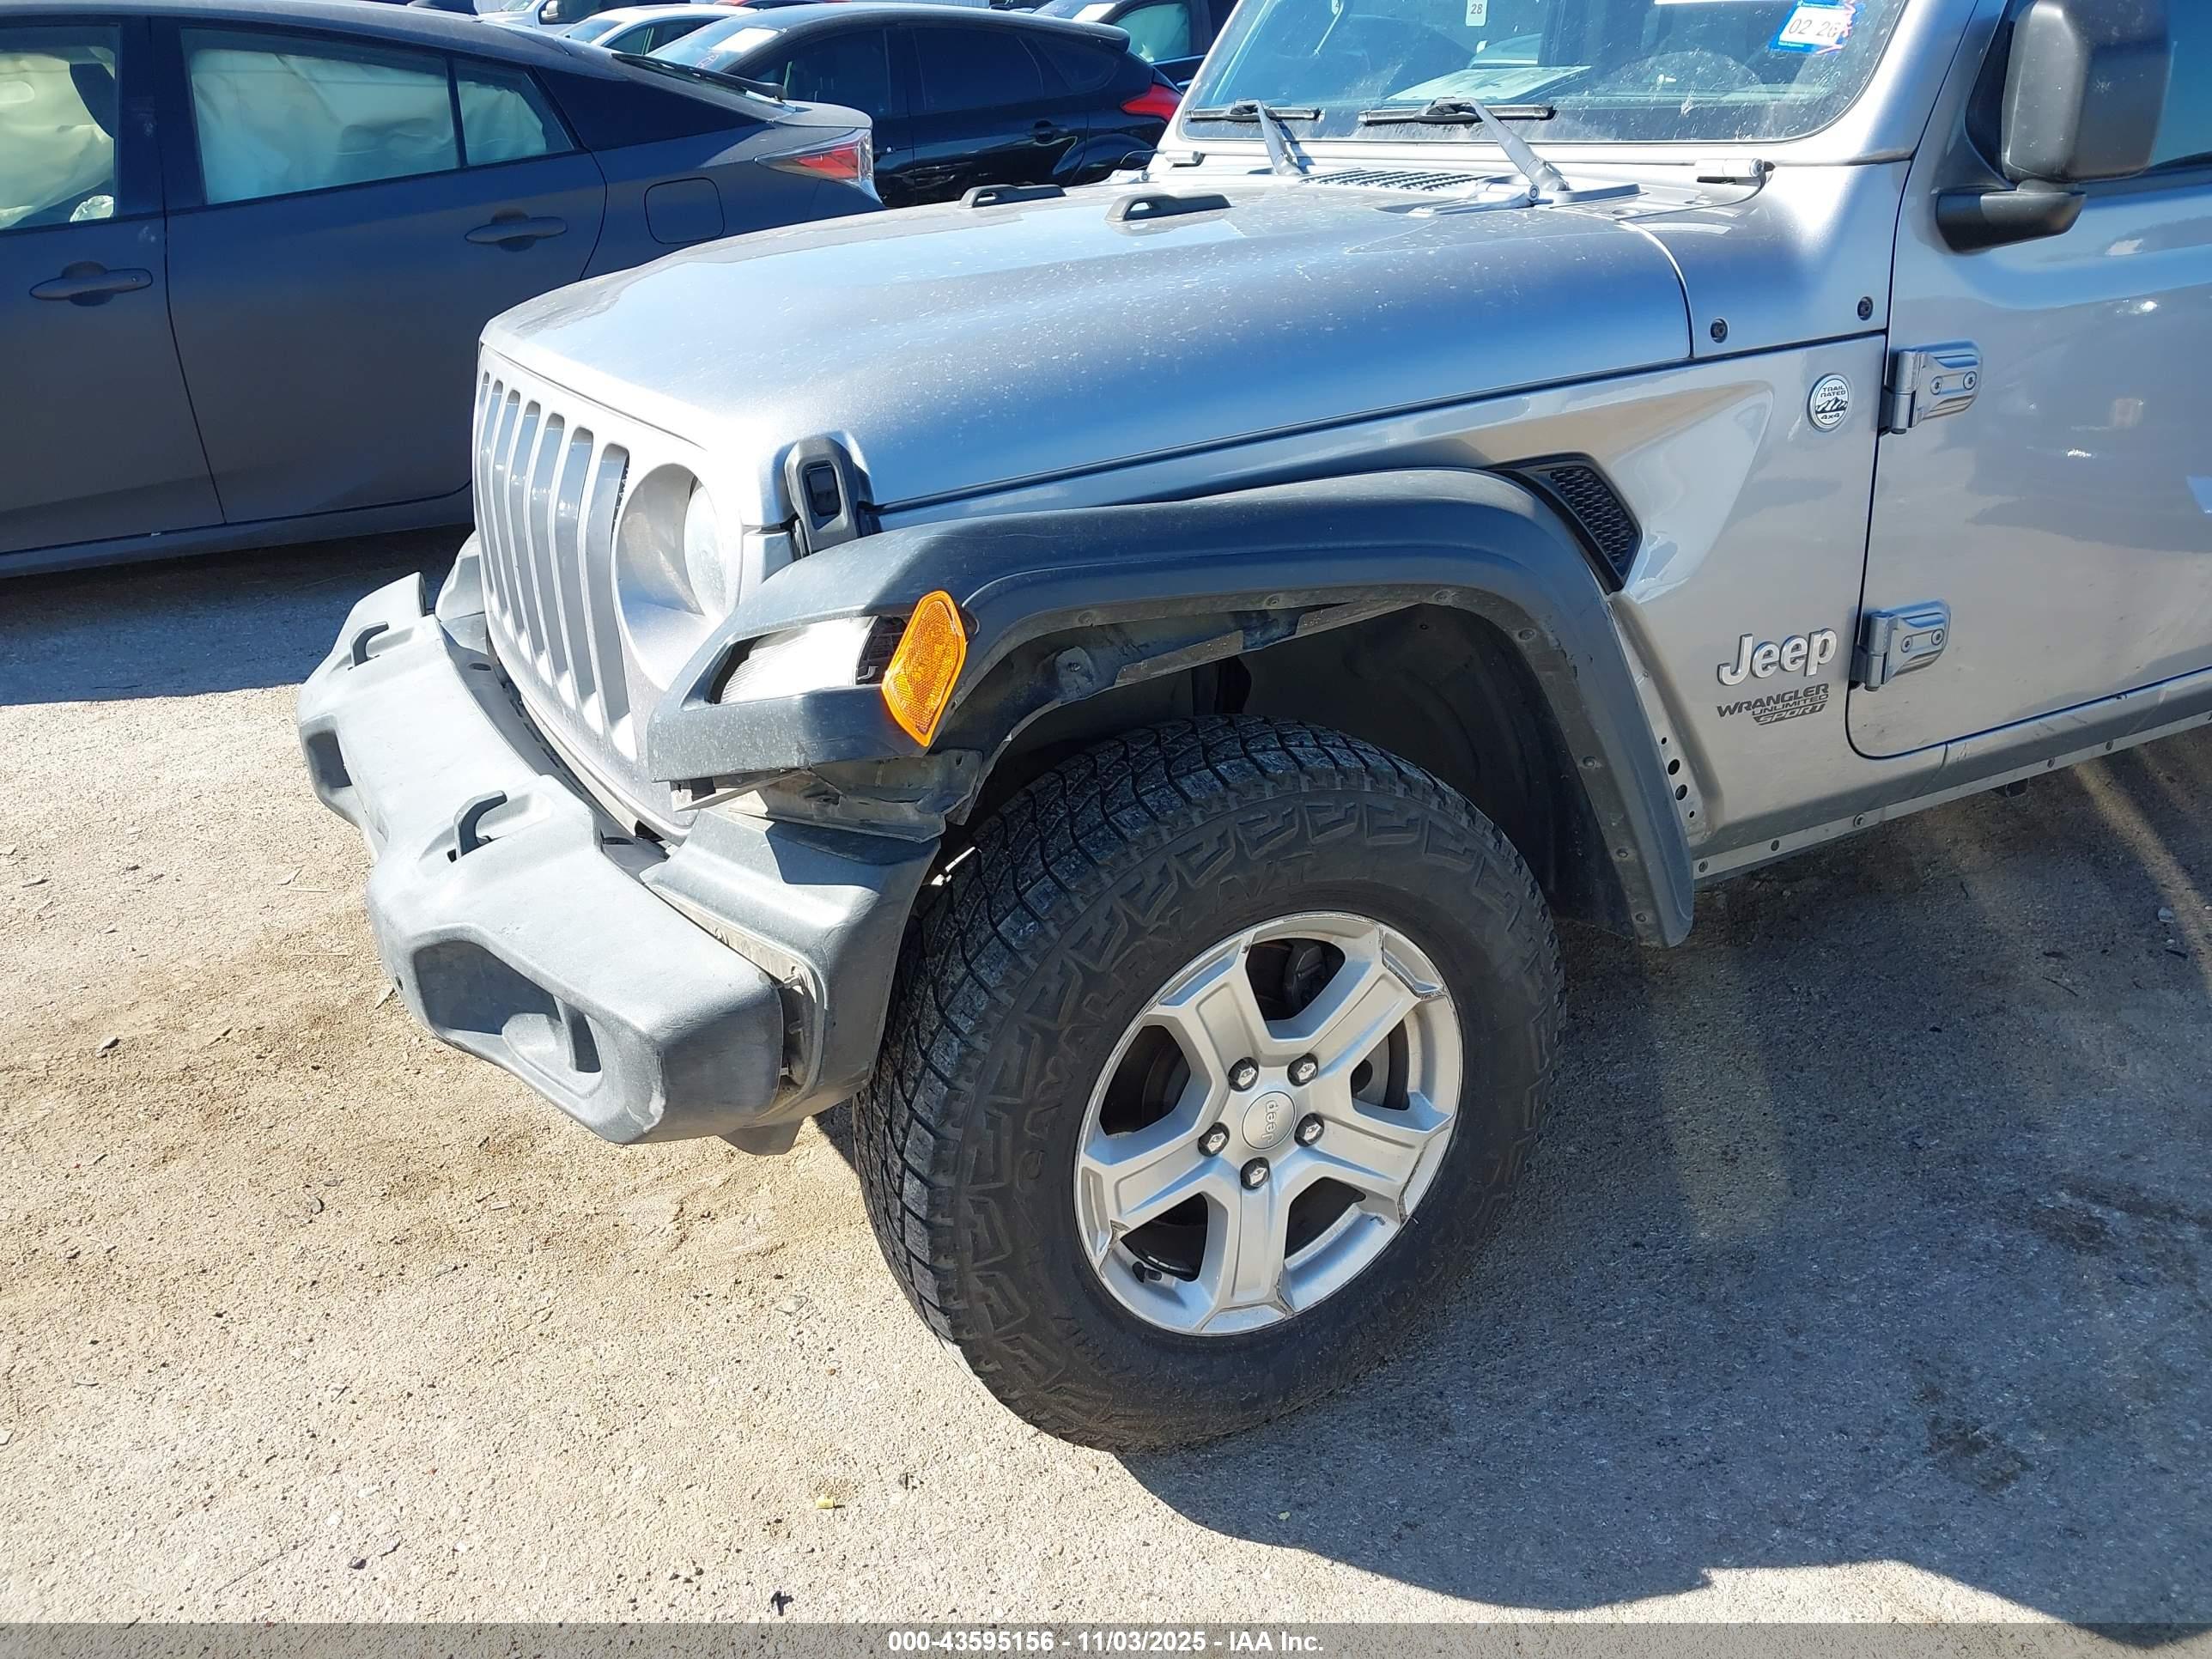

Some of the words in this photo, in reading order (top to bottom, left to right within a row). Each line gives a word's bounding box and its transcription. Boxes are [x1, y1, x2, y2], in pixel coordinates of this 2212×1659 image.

[1470, 3, 1484, 15] 28
[1788, 18, 1813, 35] 02
[1820, 390, 1846, 398] RATED
[1717, 627, 1838, 685] Jeep
[1717, 683, 1829, 718] WRANGLER
[1752, 694, 1829, 716] UNLIMITED
[1755, 702, 1826, 725] SPORT
[1260, 1099, 1279, 1145] Jeep
